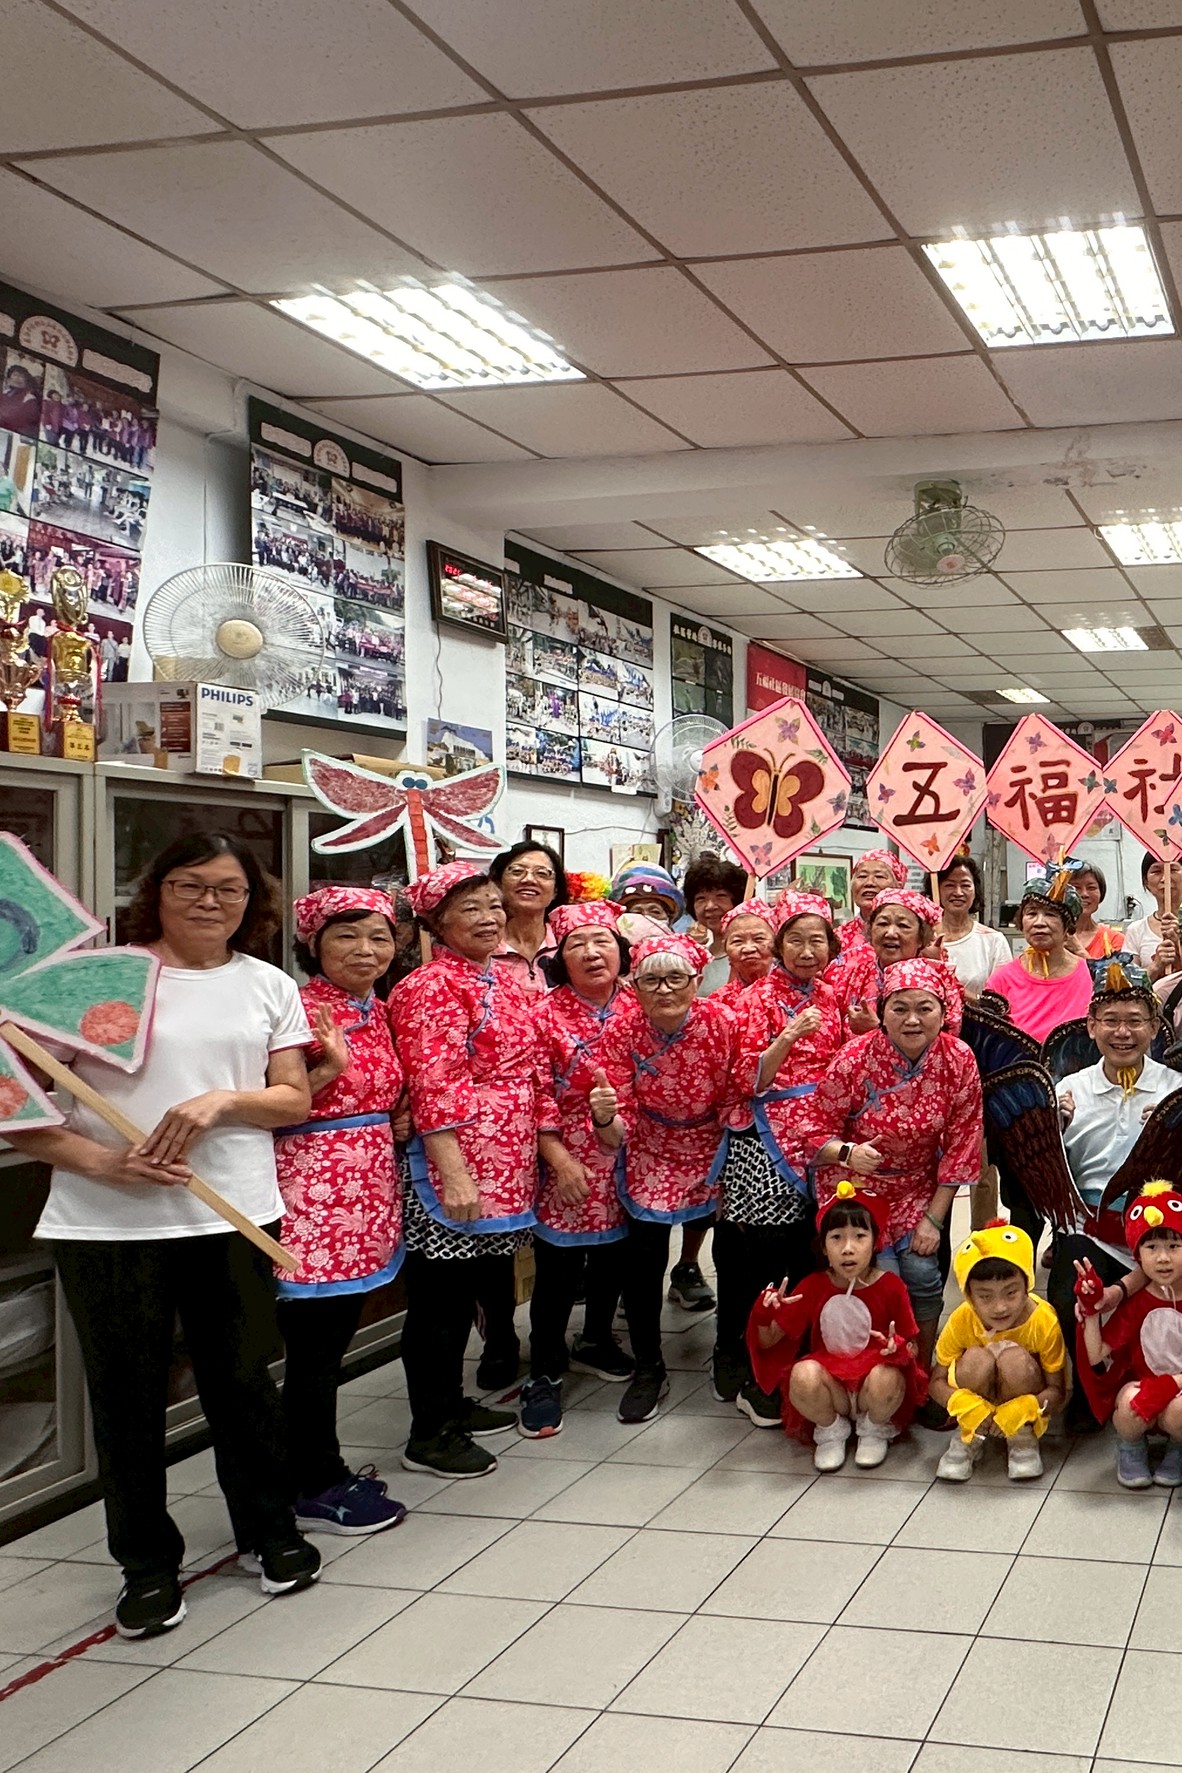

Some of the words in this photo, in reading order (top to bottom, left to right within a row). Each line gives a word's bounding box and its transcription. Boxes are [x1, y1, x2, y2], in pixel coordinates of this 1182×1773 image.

[201, 687, 254, 706] PHILIPS
[892, 761, 961, 827] 五
[1004, 759, 1080, 831] 福
[1123, 752, 1182, 823] 社
